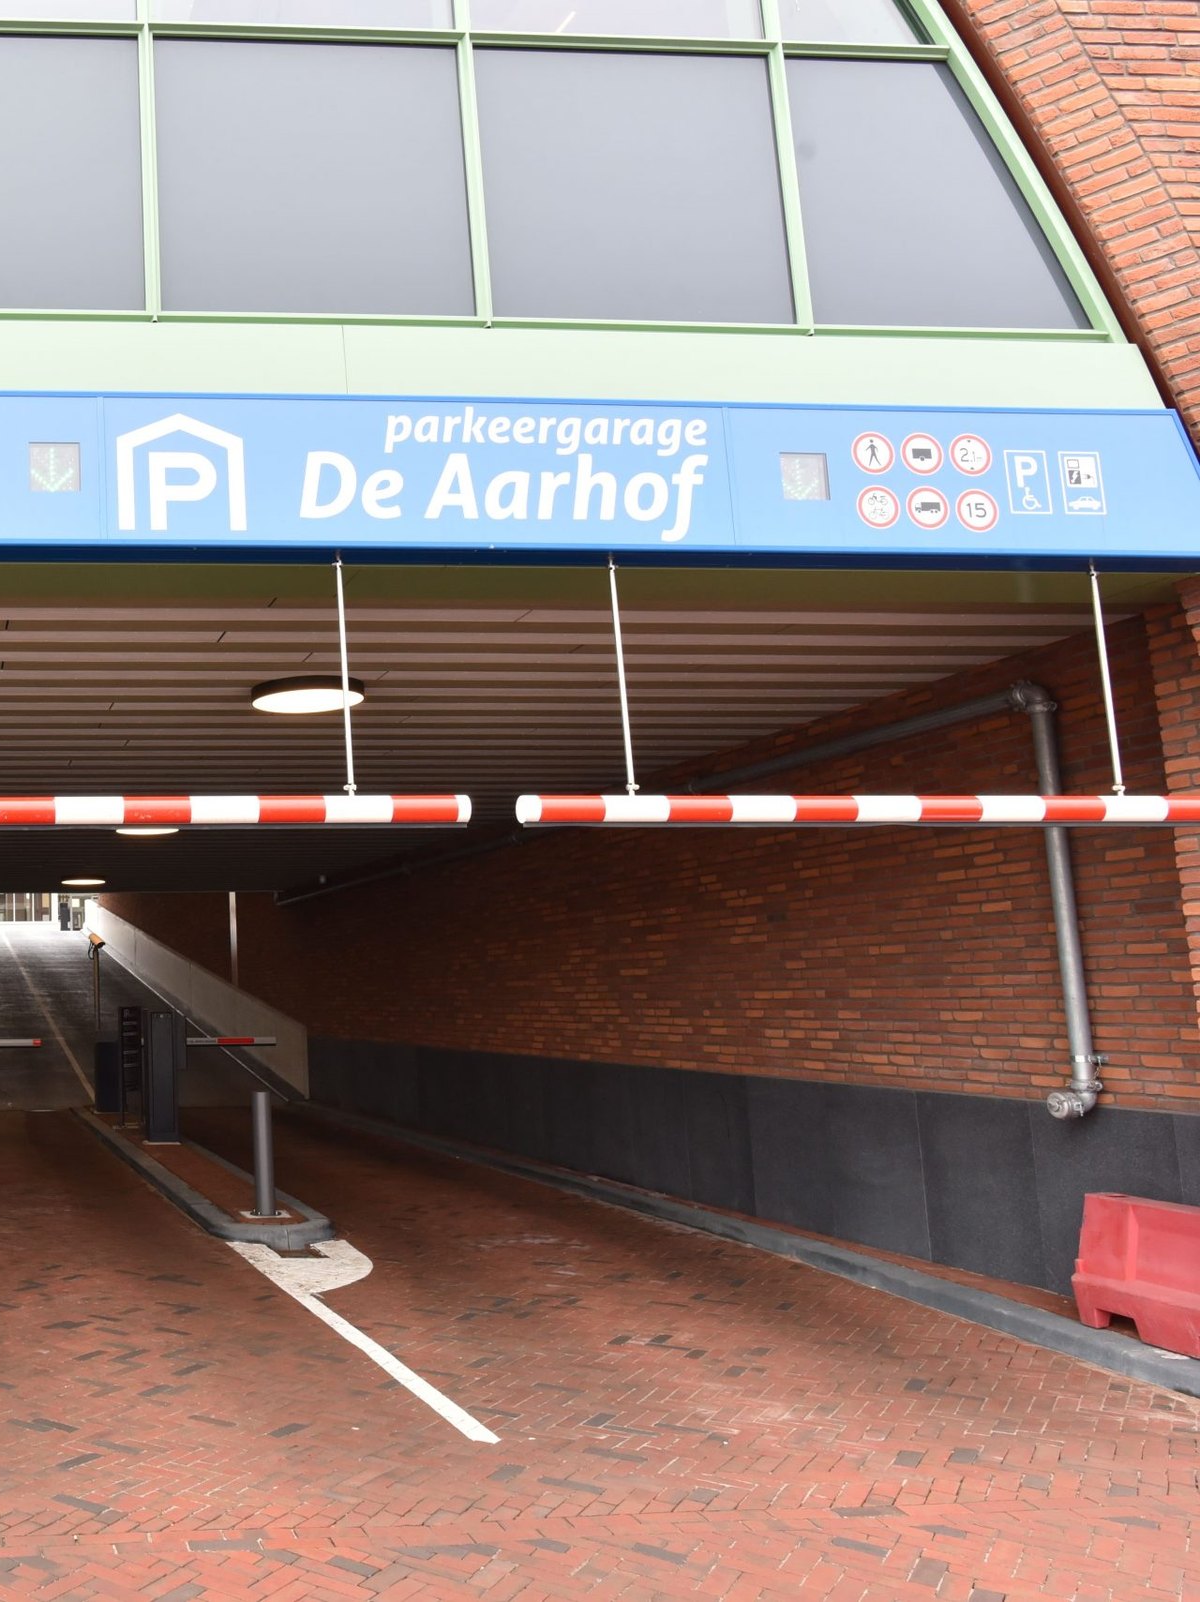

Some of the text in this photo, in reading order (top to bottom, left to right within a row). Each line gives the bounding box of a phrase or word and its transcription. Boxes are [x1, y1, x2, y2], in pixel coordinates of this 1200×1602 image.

[383, 405, 708, 457] parkeergarage
[1014, 455, 1038, 487] P
[299, 450, 709, 543] De Aarhof
[966, 502, 987, 518] 15
